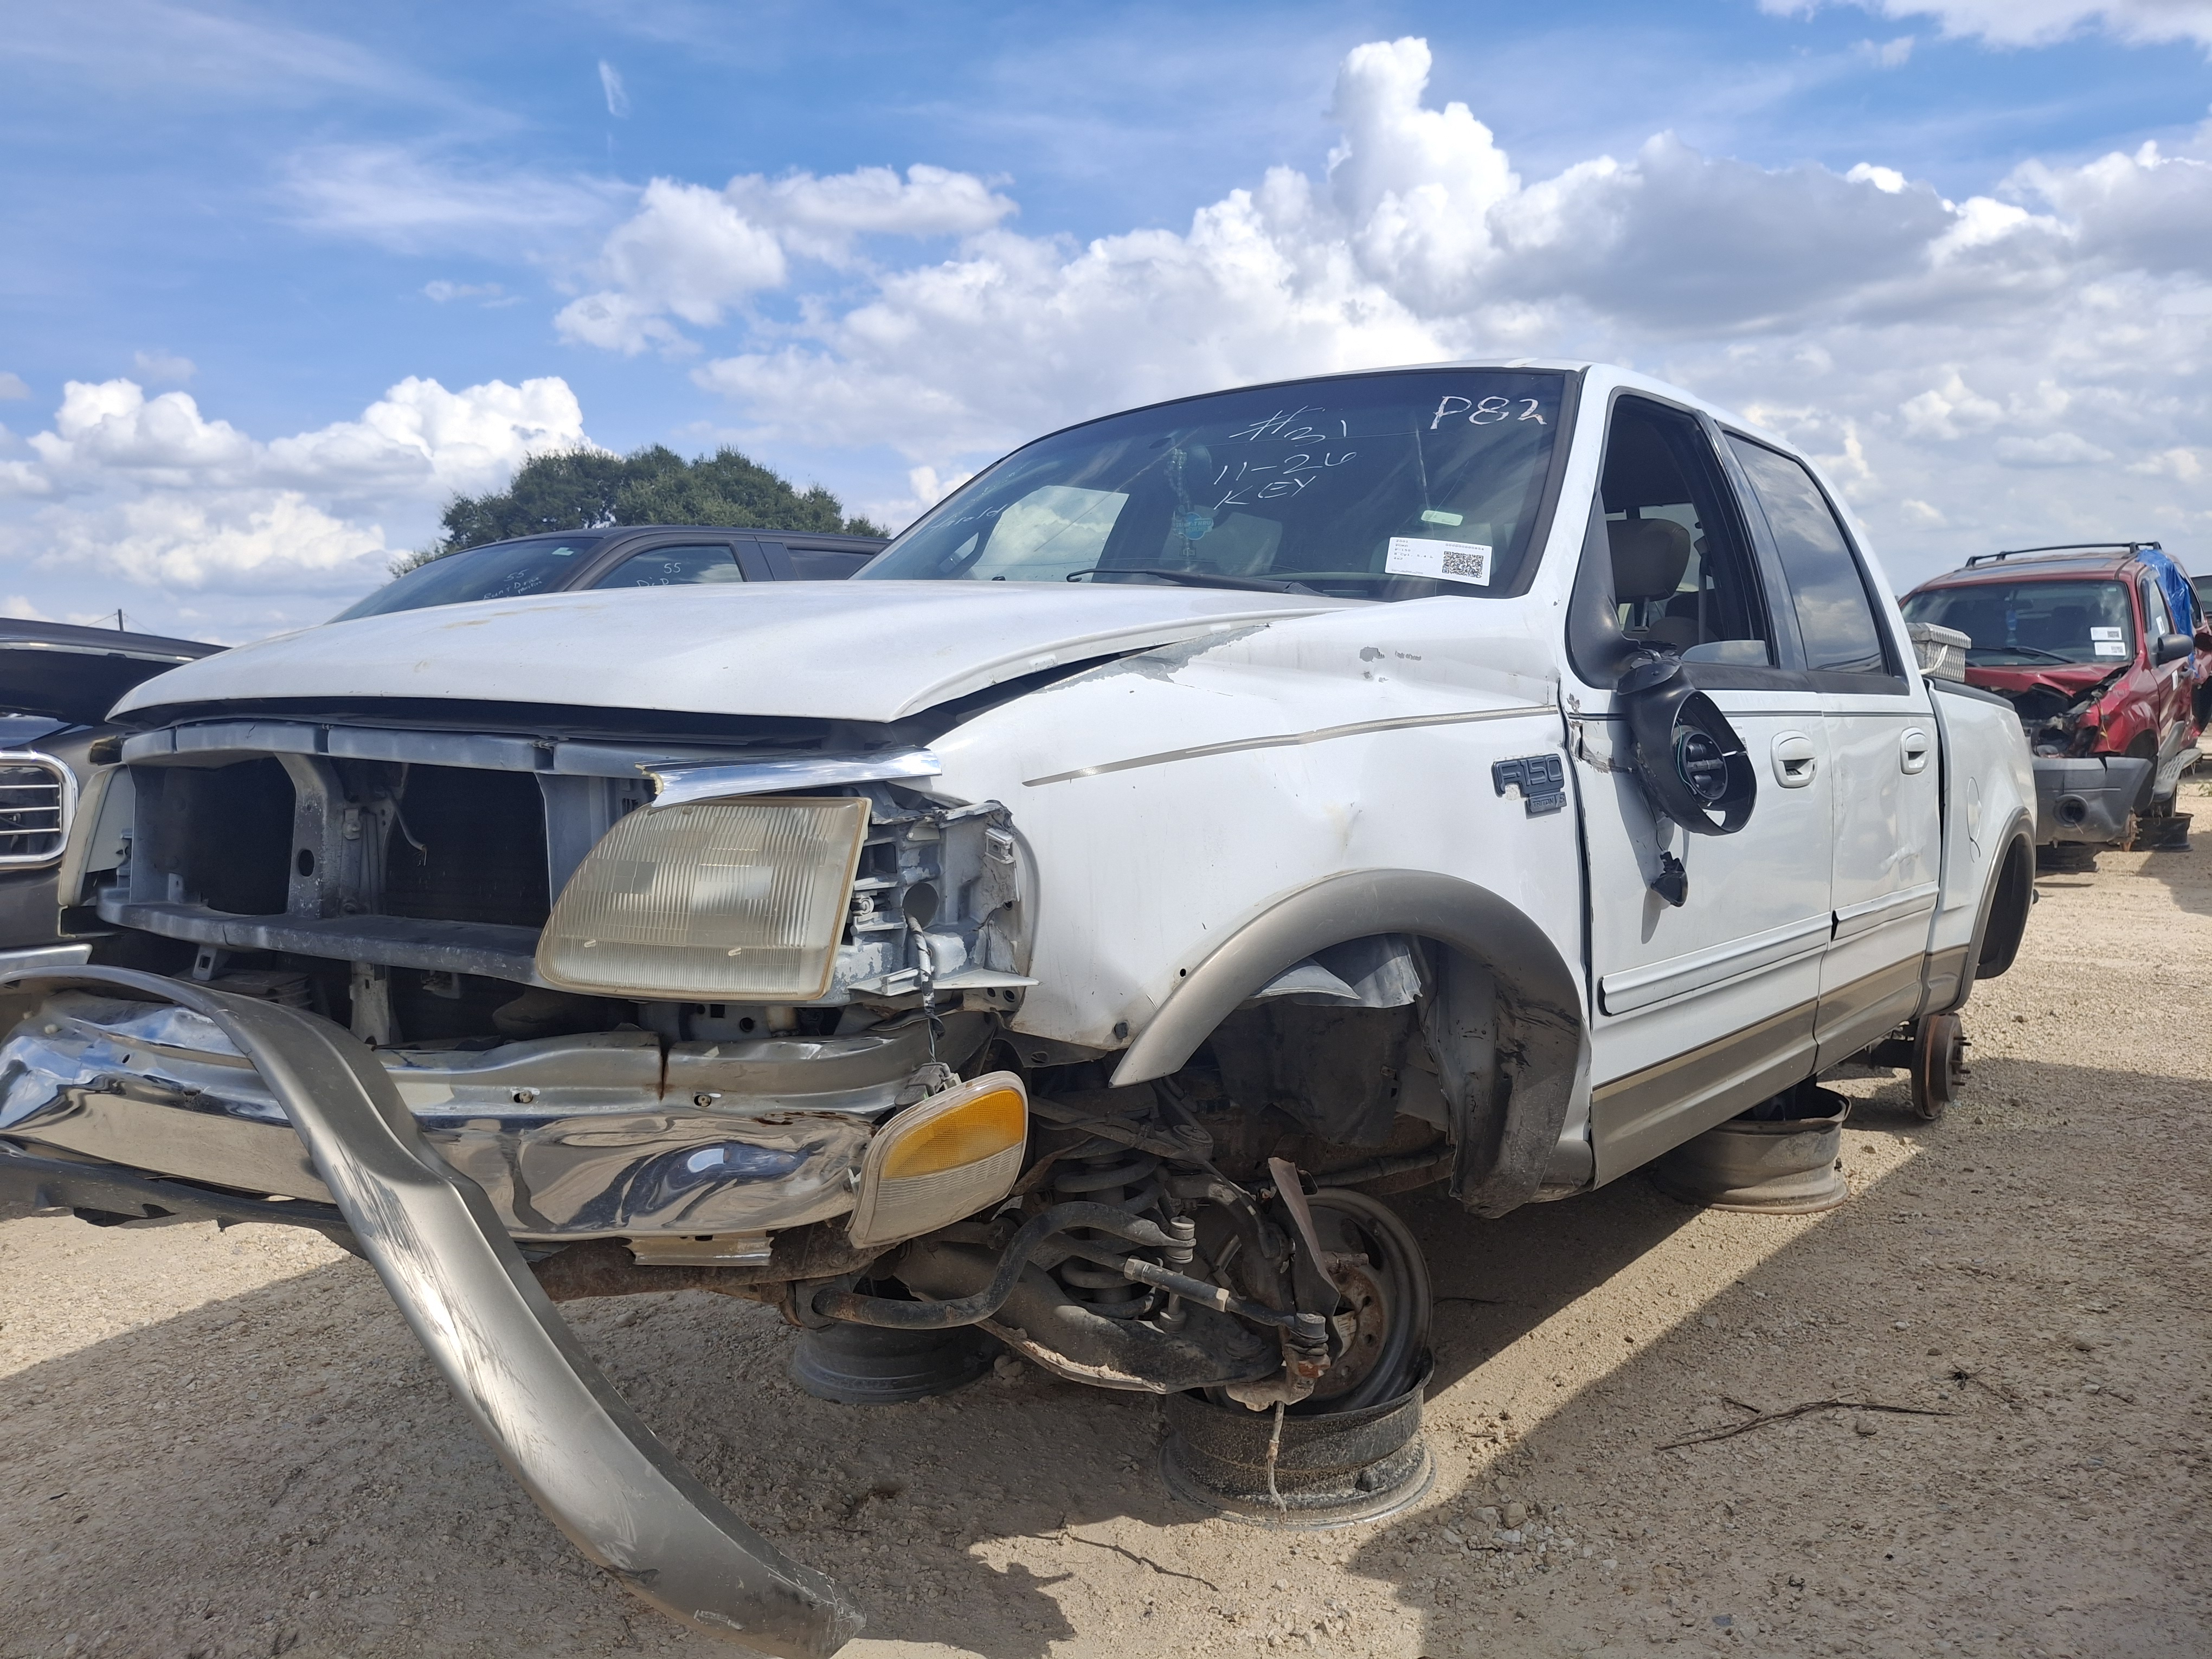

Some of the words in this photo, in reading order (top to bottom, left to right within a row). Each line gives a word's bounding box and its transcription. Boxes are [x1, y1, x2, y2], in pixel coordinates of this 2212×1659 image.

[1430, 395, 1547, 430] P82
[1213, 452, 1357, 485] 11-26
[1213, 475, 1317, 510] KEY
[503, 568, 530, 582] 55
[664, 562, 682, 574] 55
[1494, 754, 1564, 795] F-150
[1532, 797, 1554, 808] TRITON
[1554, 793, 1565, 807] V8
